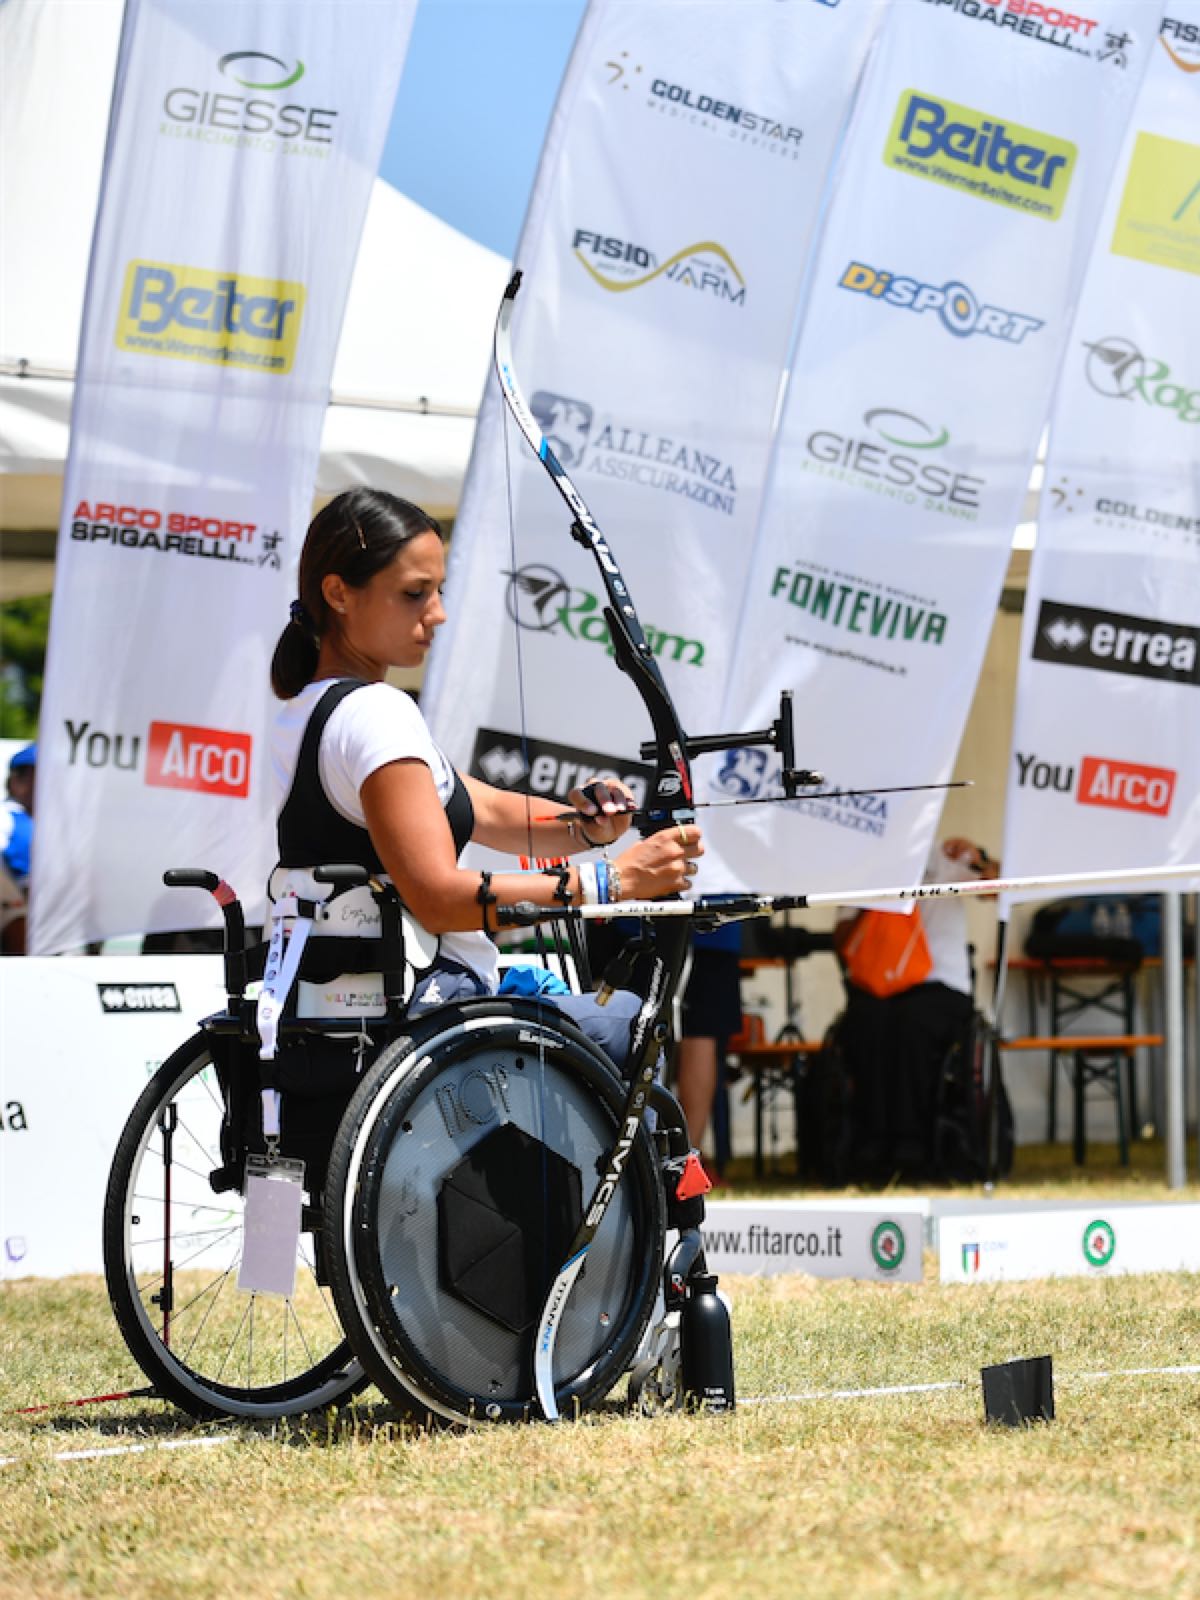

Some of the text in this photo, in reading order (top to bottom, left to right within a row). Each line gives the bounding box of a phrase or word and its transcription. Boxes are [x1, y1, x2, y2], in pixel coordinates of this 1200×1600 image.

[164, 87, 338, 143] GIESSE
[898, 94, 1067, 190] Beiter
[128, 265, 295, 341] Beiter
[586, 456, 736, 515] ASSICURAZIONI
[593, 424, 736, 491] ALLEANZA
[807, 431, 985, 508] GIESSE
[70, 521, 238, 560] SPIGARELLI
[73, 500, 257, 542] ARCO SPORT
[556, 587, 705, 667] Raim
[771, 566, 948, 645] FONTEVIVA
[1089, 622, 1198, 673] errea
[64, 719, 247, 787] You Arco
[1016, 752, 1169, 809] You Arco
[701, 1224, 843, 1258] ww.fitarco.it
